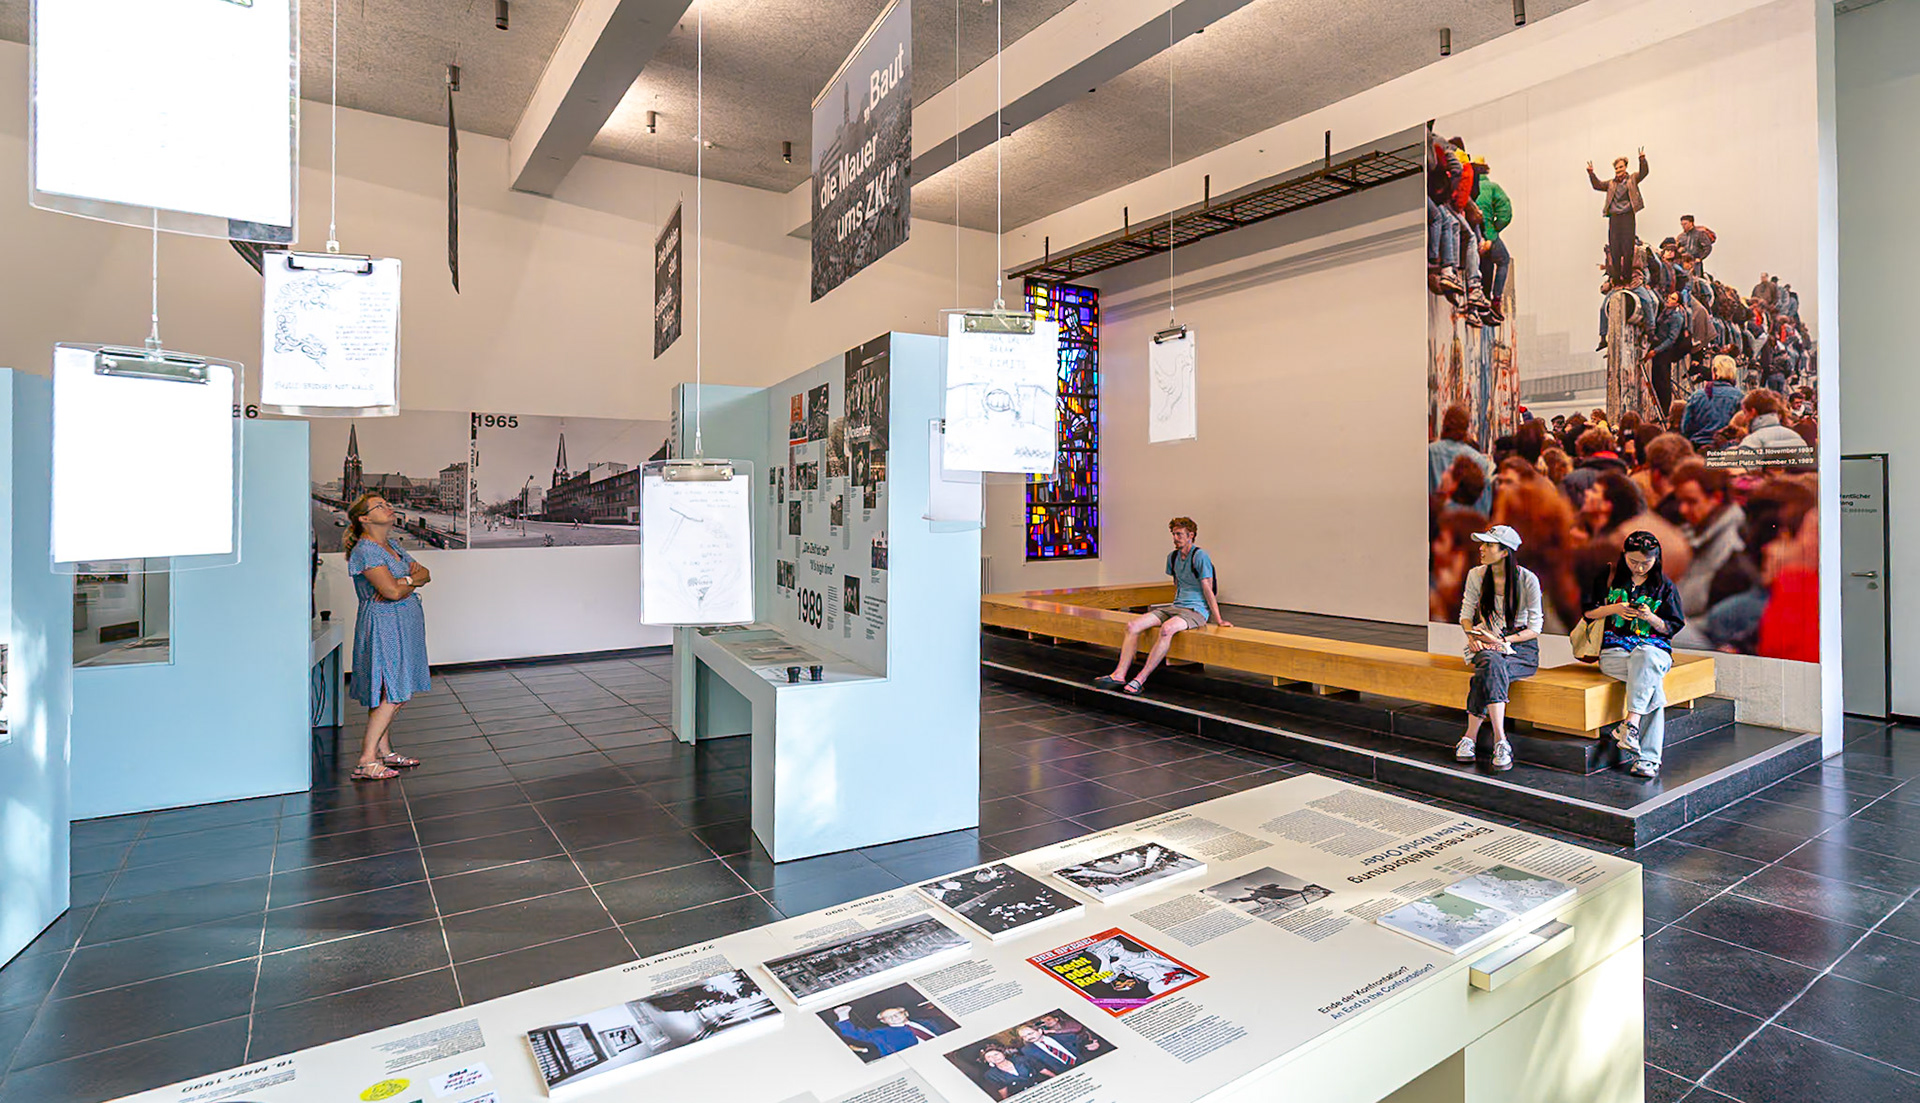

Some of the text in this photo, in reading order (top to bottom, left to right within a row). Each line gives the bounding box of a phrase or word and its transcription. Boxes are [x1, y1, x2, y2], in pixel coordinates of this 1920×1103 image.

[863, 42, 905, 124] „Baut
[820, 132, 879, 210] die Mauer
[837, 159, 898, 243] ums ZK!“
[475, 415, 519, 429] 1965
[797, 587, 823, 630] 1989
[1360, 821, 1475, 867] A New World Order
[1347, 826, 1495, 884] Eine neue Weltordnung
[825, 906, 848, 916] 1990
[849, 896, 884, 909] Februar
[1053, 937, 1098, 955] SPIEGEL
[653, 949, 699, 965] Februar
[1052, 956, 1092, 974] Recht
[622, 961, 651, 973] 1990
[1064, 965, 1096, 981] oder
[1072, 970, 1115, 988] Rache
[1318, 965, 1410, 1014] Ende der Konfrontation?
[1331, 963, 1436, 1020] An End to the Confrontation?
[228, 1065, 268, 1080] März
[181, 1078, 222, 1094] 1990
